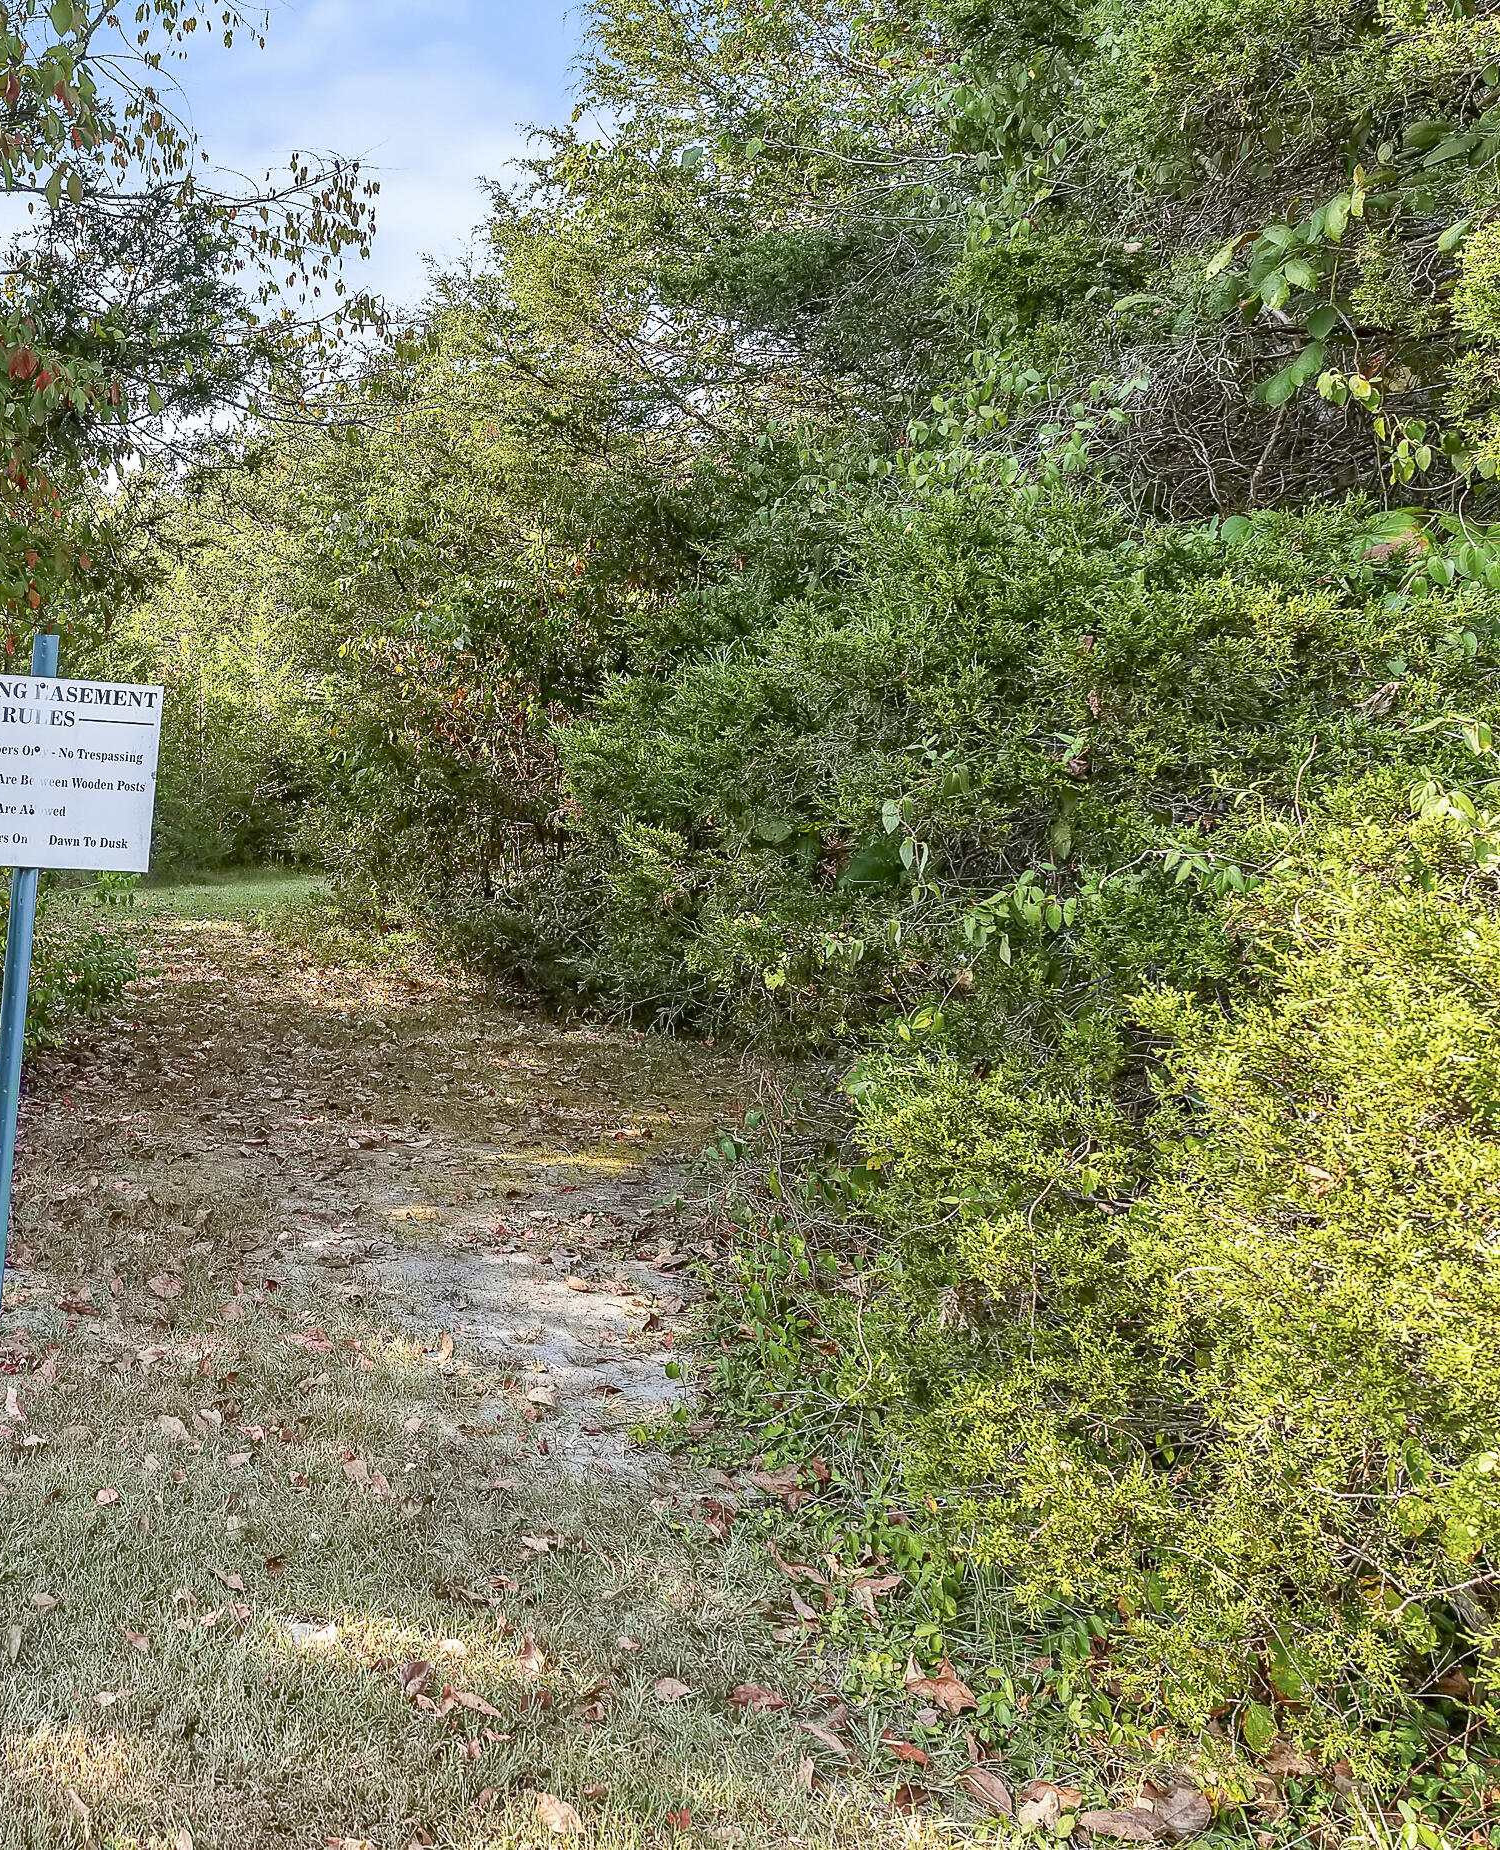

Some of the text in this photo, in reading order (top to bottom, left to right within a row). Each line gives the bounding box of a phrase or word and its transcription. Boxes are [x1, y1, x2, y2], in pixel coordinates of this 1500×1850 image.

[58, 748, 74, 758] No
[77, 749, 143, 764] Trespassing
[72, 777, 114, 790] Wooden
[117, 781, 145, 792] Posts
[49, 835, 80, 846] Dawn
[84, 837, 96, 847] To
[100, 838, 128, 849] Dusk
